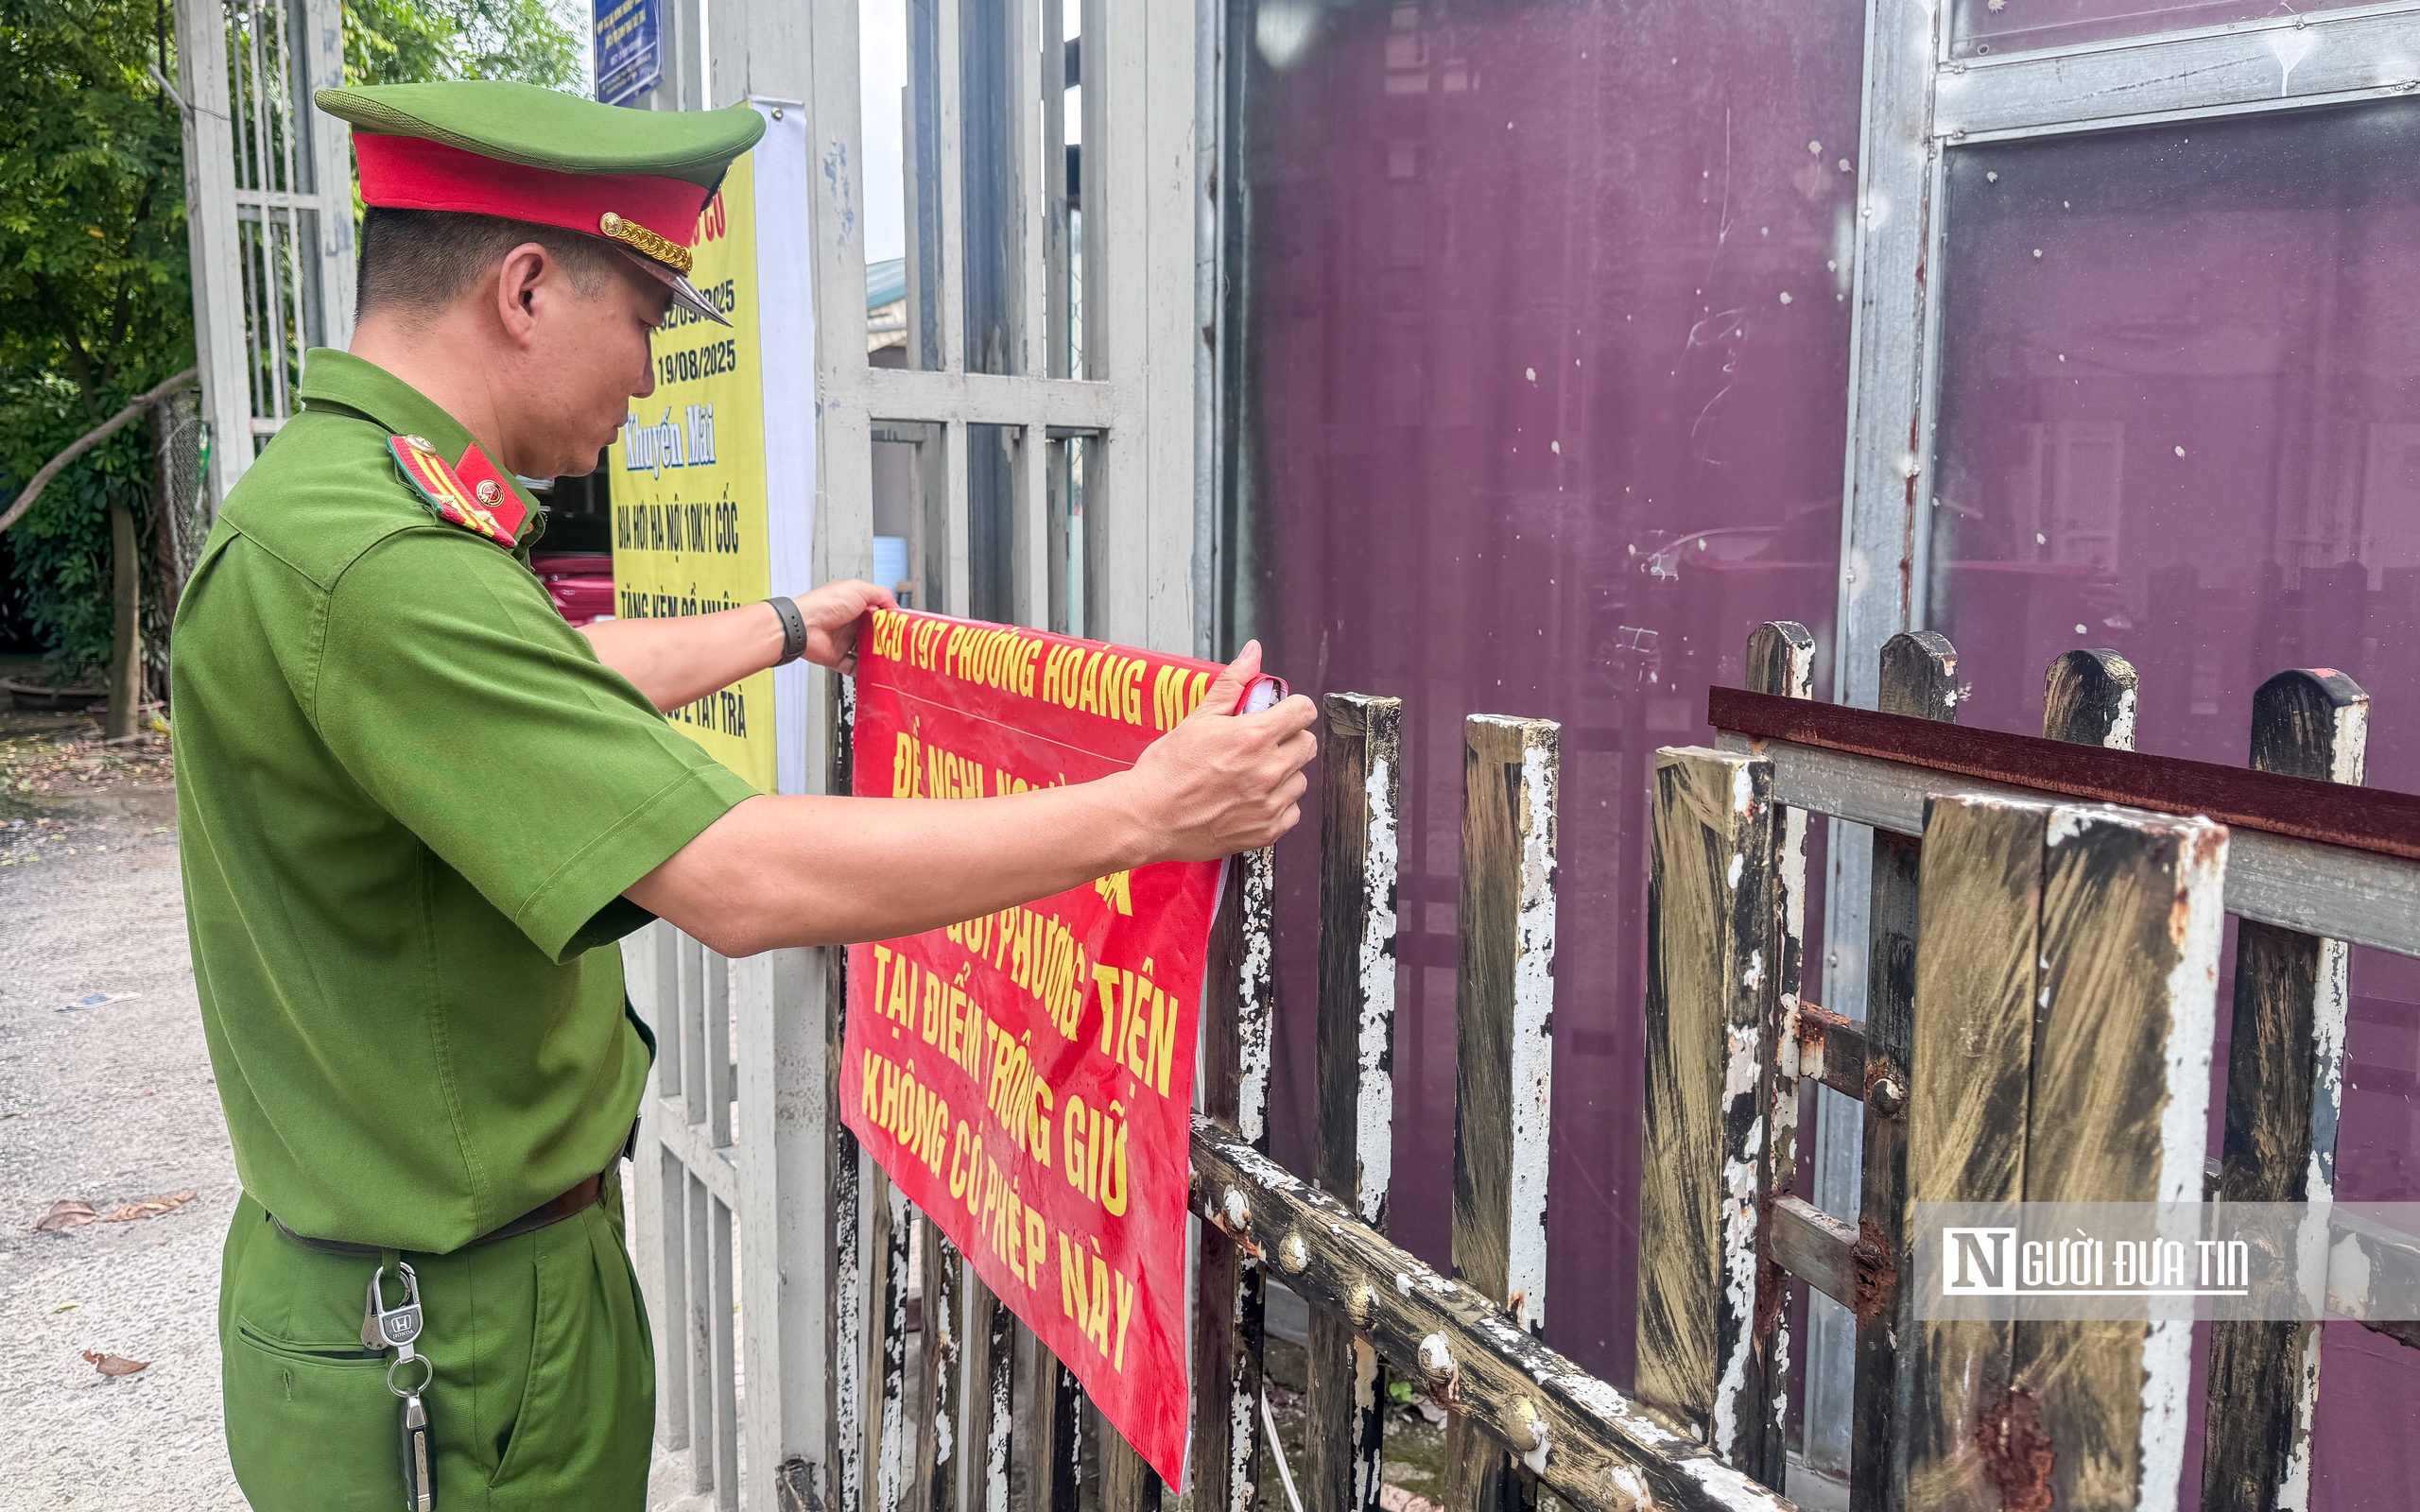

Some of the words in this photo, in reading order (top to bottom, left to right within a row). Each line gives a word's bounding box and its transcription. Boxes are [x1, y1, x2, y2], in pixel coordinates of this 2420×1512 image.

[659, 339, 735, 386] 19/08/2025
[625, 405, 683, 481] Khuyến
[617, 505, 631, 550] BIA
[650, 493, 664, 551] HÀ
[666, 492, 683, 563] NỘI
[716, 482, 738, 555] CỐC
[910, 618, 950, 672] 197
[720, 683, 747, 739] TRÀ
[892, 715, 925, 799] ĐỀ
[994, 904, 1086, 1041] PHƯƠNG
[1092, 956, 1179, 1099] TIỆN
[874, 944, 919, 1040] TẠI
[922, 961, 983, 1085] ĐIỂM
[985, 1028, 1054, 1168] TRÔNG
[1063, 1094, 1128, 1217] GIỮ
[861, 1047, 948, 1179] KHÔNG
[949, 1119, 983, 1216] CÓ
[981, 1155, 1046, 1292] PHÉP
[1058, 1229, 1134, 1375] NÀY
